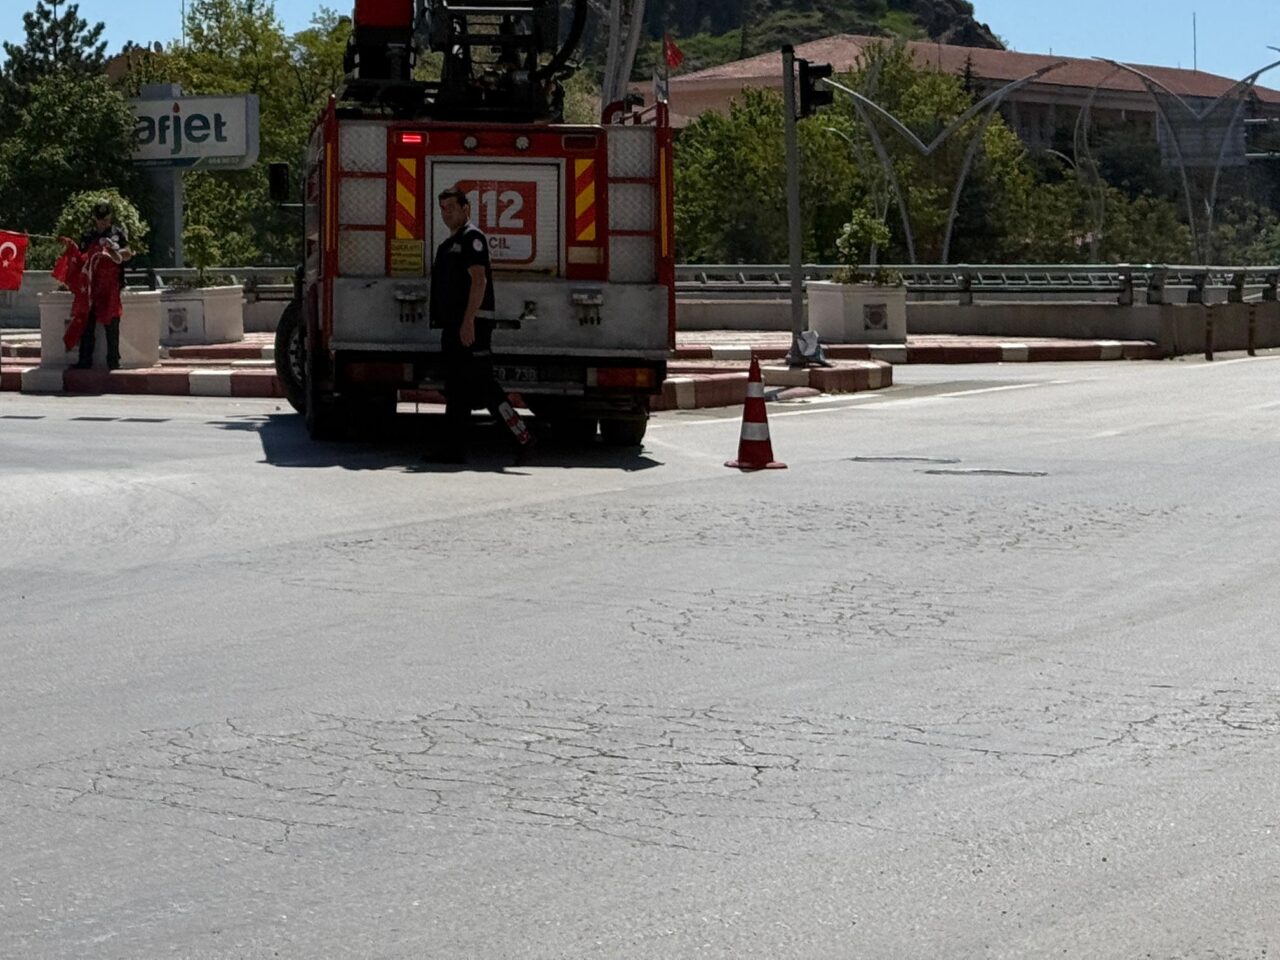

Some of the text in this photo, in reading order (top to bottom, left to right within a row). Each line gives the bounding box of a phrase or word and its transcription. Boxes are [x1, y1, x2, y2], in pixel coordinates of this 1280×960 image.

[136, 101, 228, 155] afjet
[465, 190, 524, 228] 112
[488, 236, 511, 249] CIL
